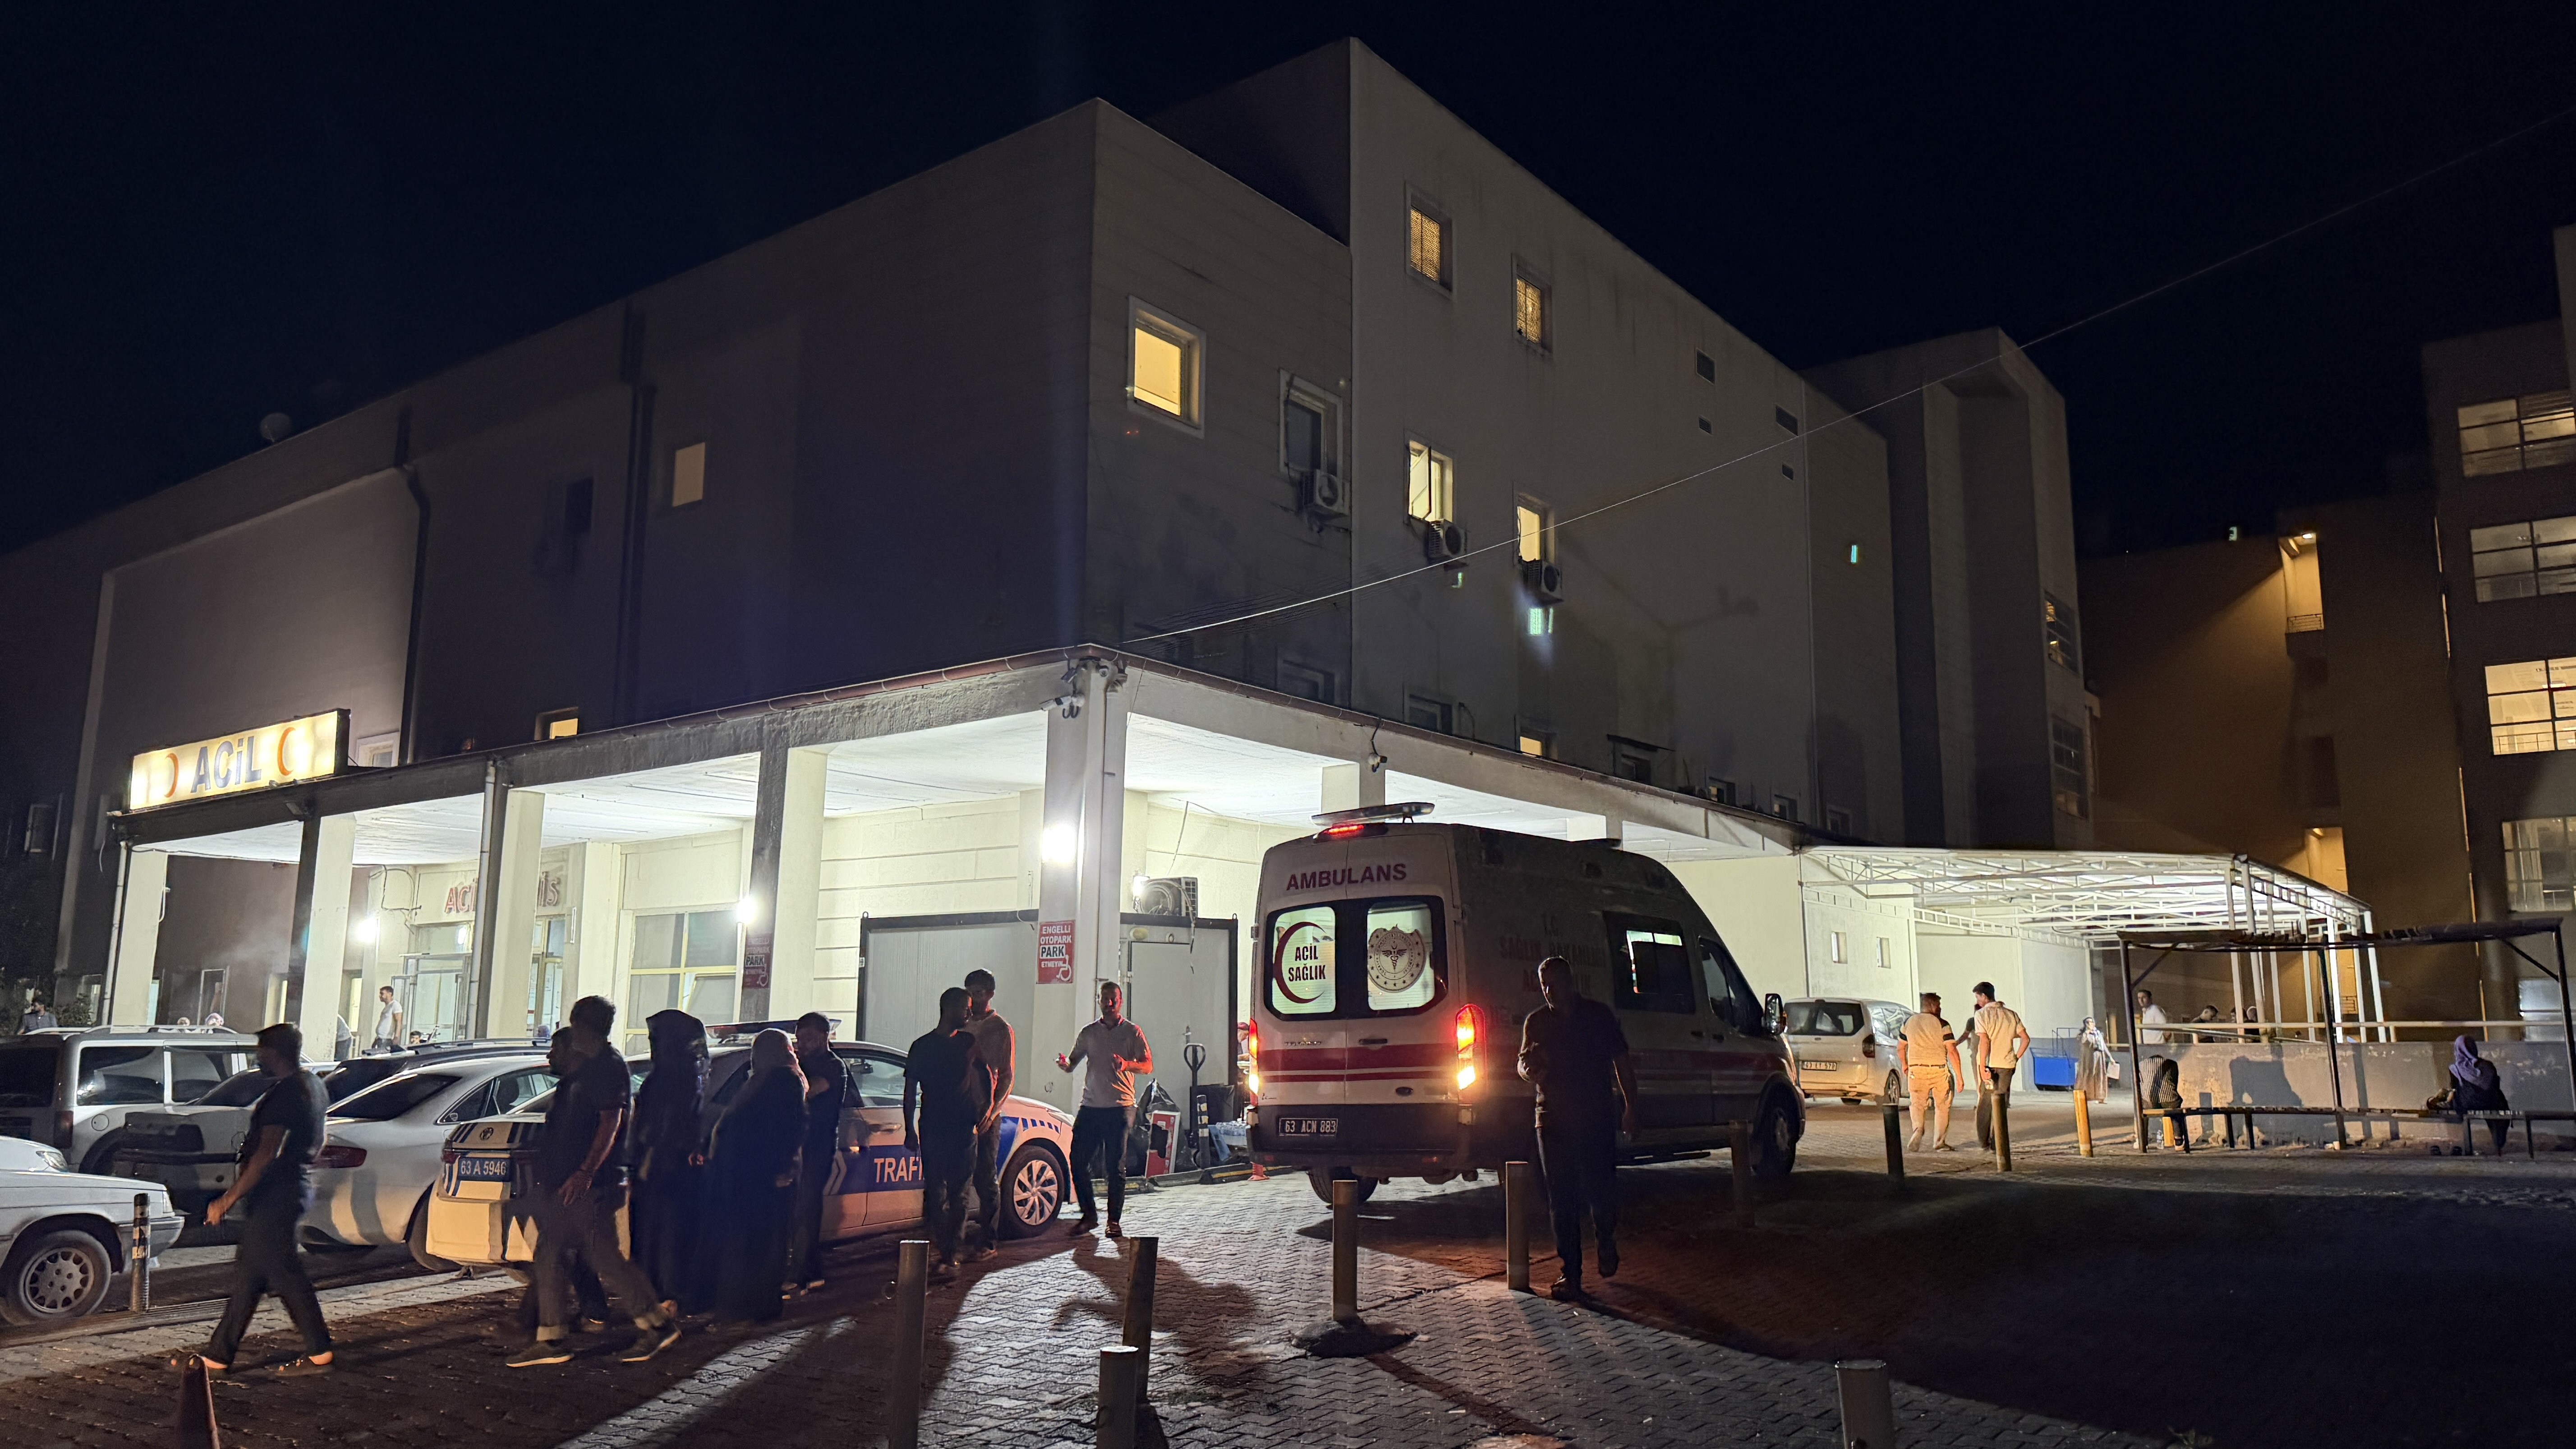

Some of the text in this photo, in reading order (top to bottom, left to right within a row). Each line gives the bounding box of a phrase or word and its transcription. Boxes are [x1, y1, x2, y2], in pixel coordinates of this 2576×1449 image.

[190, 736, 262, 793] ACİL
[1286, 863, 1407, 891] AMBULANS
[444, 878, 479, 914] ACİ
[1040, 935, 1072, 944] OTOPARK
[1041, 946, 1064, 957] PARK
[1295, 943, 1318, 961] ACİL
[1288, 963, 1326, 982] SAĞLIK
[1286, 1120, 1335, 1132] 63 ACN 883
[461, 1160, 506, 1175] 63 A 5946
